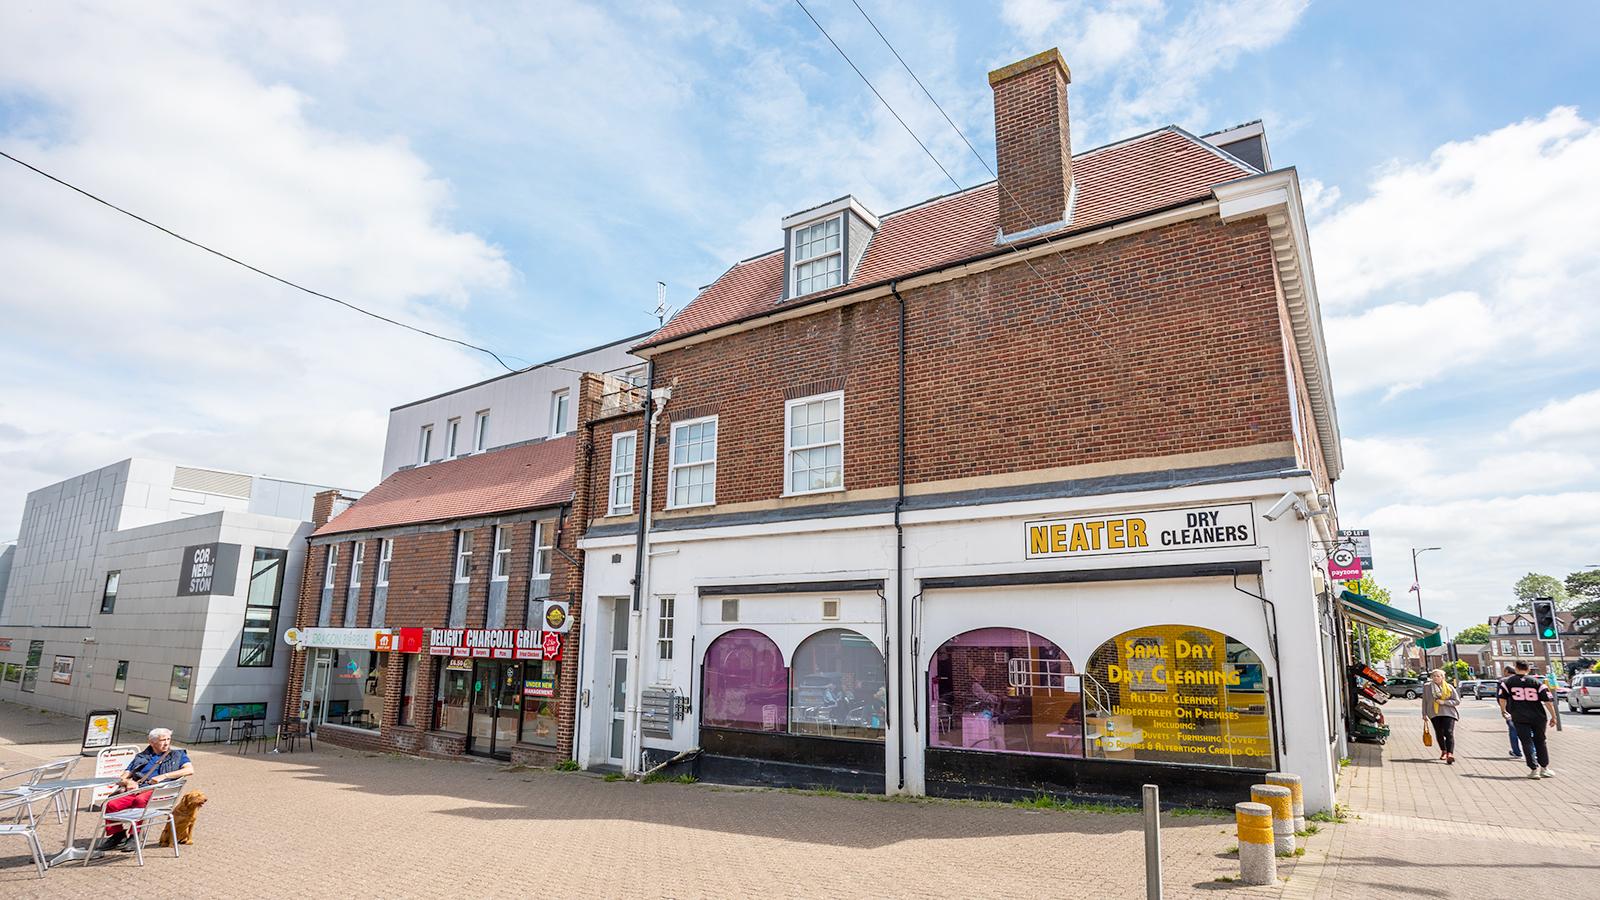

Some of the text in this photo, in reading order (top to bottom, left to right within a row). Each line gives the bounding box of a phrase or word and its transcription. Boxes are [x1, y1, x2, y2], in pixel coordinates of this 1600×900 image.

[1186, 510, 1220, 528] DRY
[1030, 518, 1149, 554] NEATER
[1160, 524, 1248, 546] CLEANERS
[194, 548, 210, 563] COR
[1331, 569, 1360, 577] payzone
[430, 629, 542, 649] DELIGHT CHARCOAL GRILL
[1125, 639, 1215, 659] SAME DAY
[1108, 664, 1241, 686] DRY CLEANING
[525, 680, 541, 688] UNDER
[524, 688, 553, 696] MANAGEMENT
[1130, 692, 1219, 705] ALL DRY CLEANING
[1511, 687, 1538, 701] 36
[1112, 705, 1240, 720] UNDERTAKEN ON PREMISES
